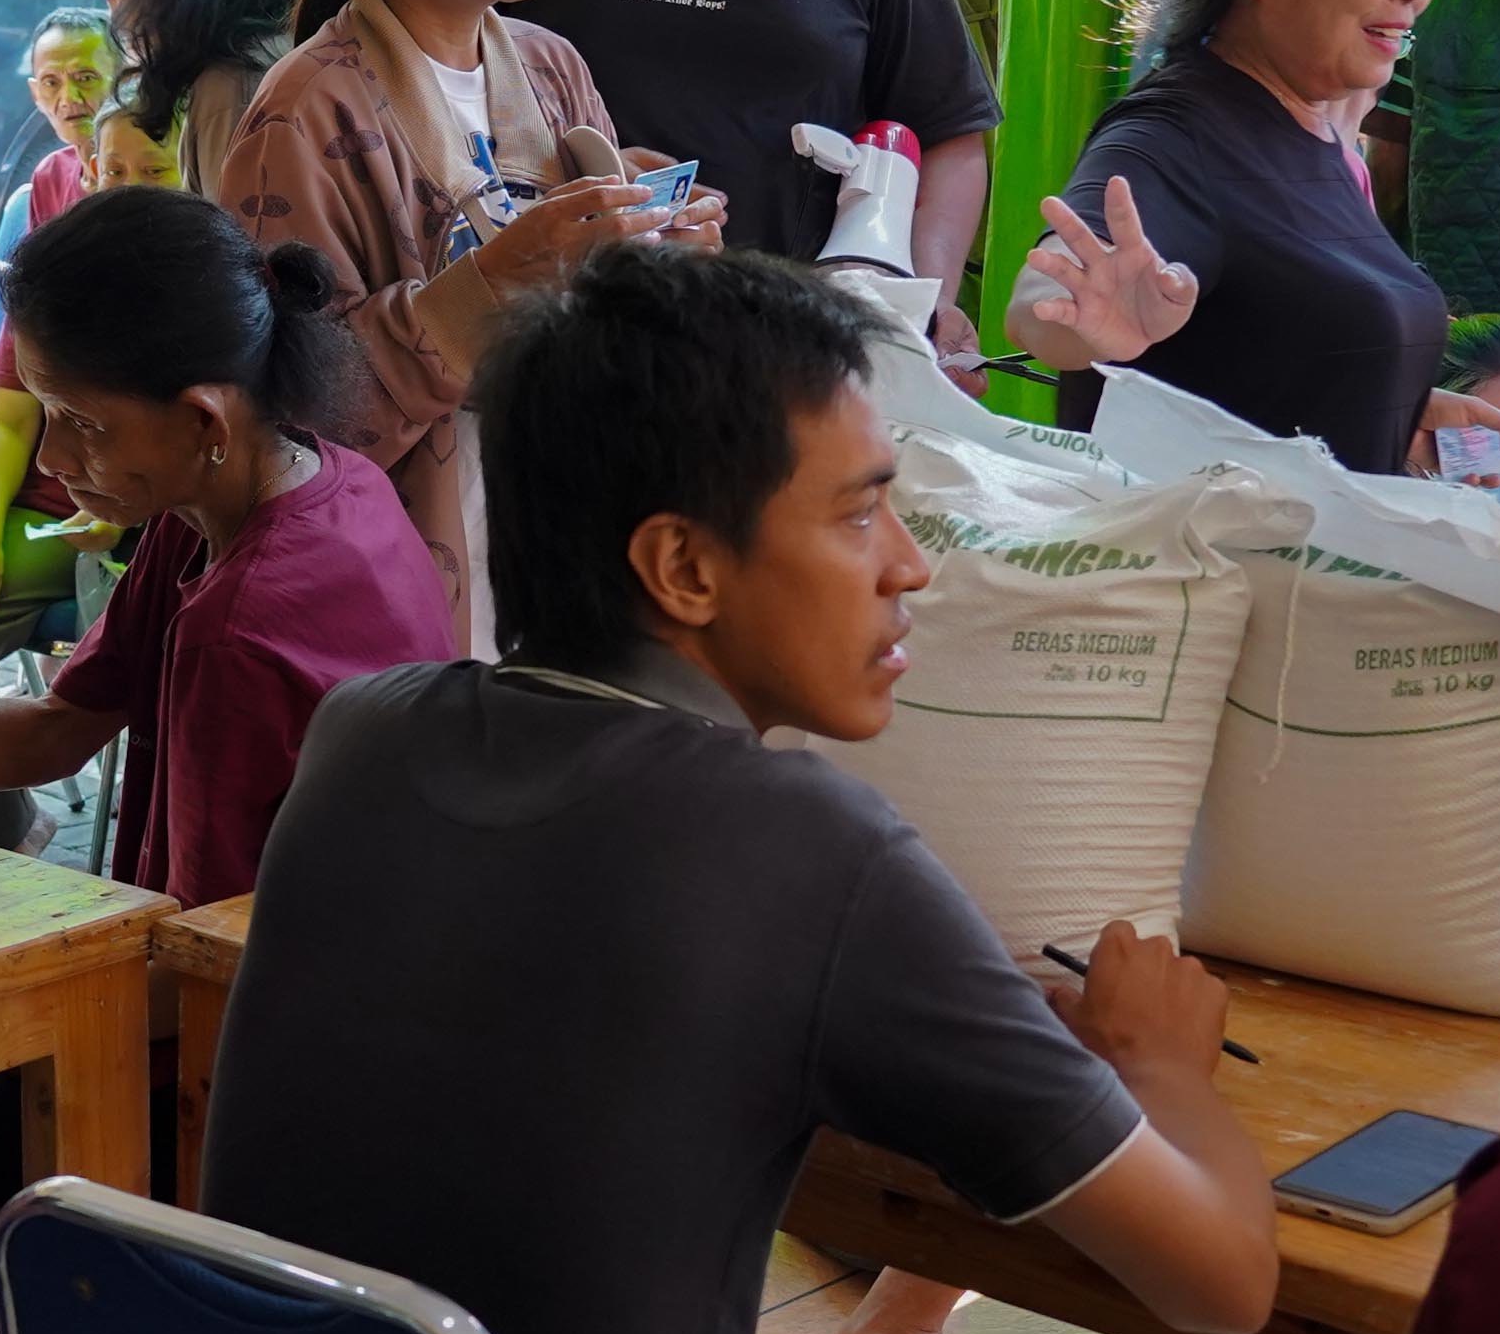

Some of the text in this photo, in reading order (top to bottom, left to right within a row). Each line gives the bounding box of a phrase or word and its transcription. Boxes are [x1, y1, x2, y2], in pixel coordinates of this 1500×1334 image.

[1011, 631, 1157, 655] BERAS MEDIUM
[1355, 640, 1499, 670] BERAS MEDIUM
[1086, 665, 1111, 682] 10
[1118, 665, 1147, 687] kg
[1434, 675, 1458, 693] 10
[1466, 673, 1495, 692] kg
